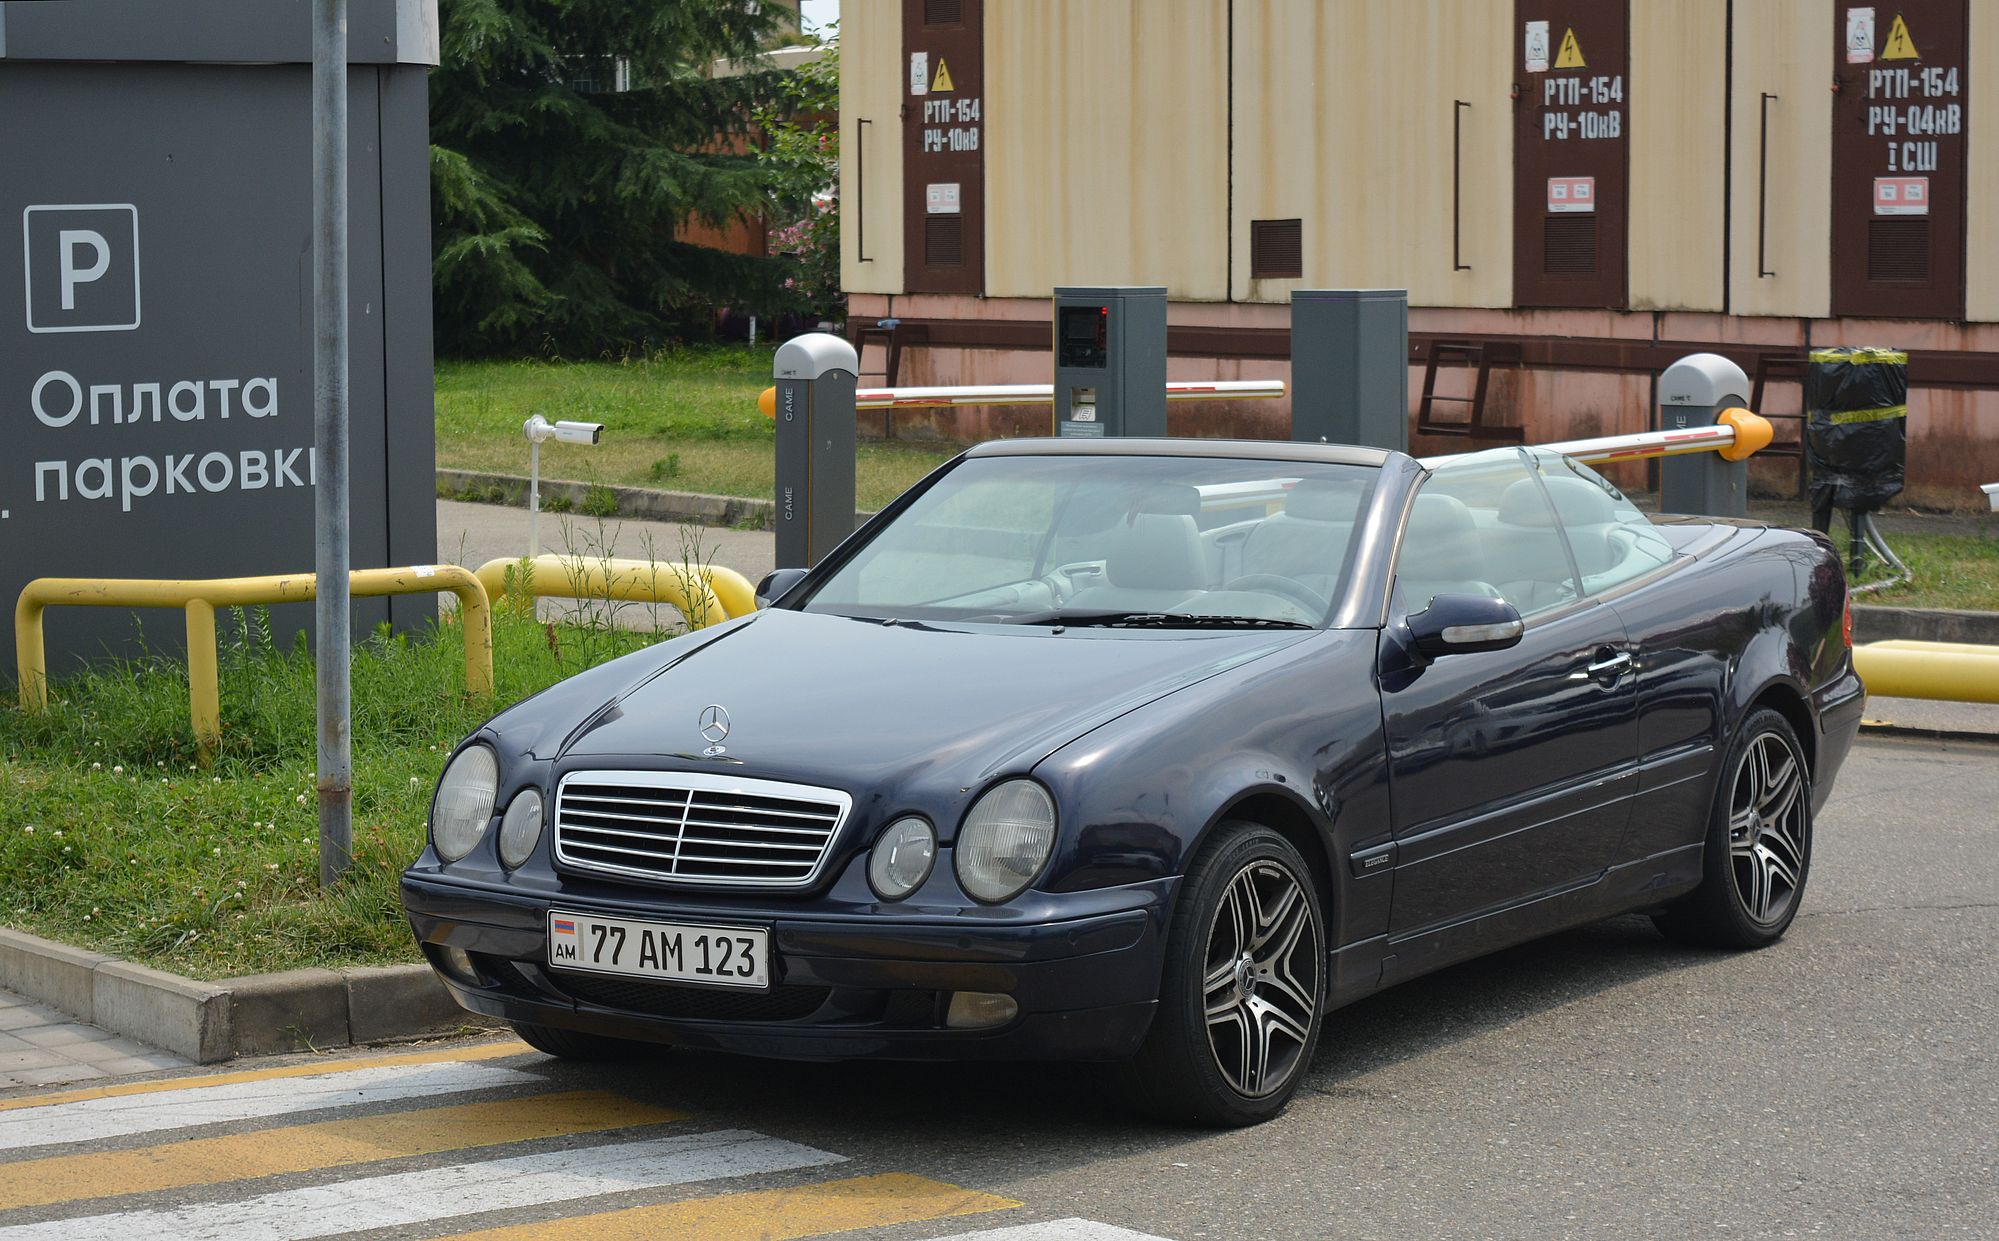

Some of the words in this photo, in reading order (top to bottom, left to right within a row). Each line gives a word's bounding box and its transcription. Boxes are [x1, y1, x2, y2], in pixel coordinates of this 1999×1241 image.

[1544, 75, 1623, 106] РТП-154
[1868, 67, 1959, 99] РТП-154
[924, 98, 980, 124] РТП-154
[1544, 110, 1621, 140] РУ-10кВ
[924, 127, 979, 153] РУ-10кВ
[31, 370, 278, 428] Оплата
[785, 387, 793, 422] CAME
[35, 447, 317, 513] парковк
[785, 486, 793, 521] CAME
[555, 943, 576, 961] AM
[591, 924, 626, 966] 77
[638, 930, 683, 972] AM
[694, 935, 755, 978] 123
